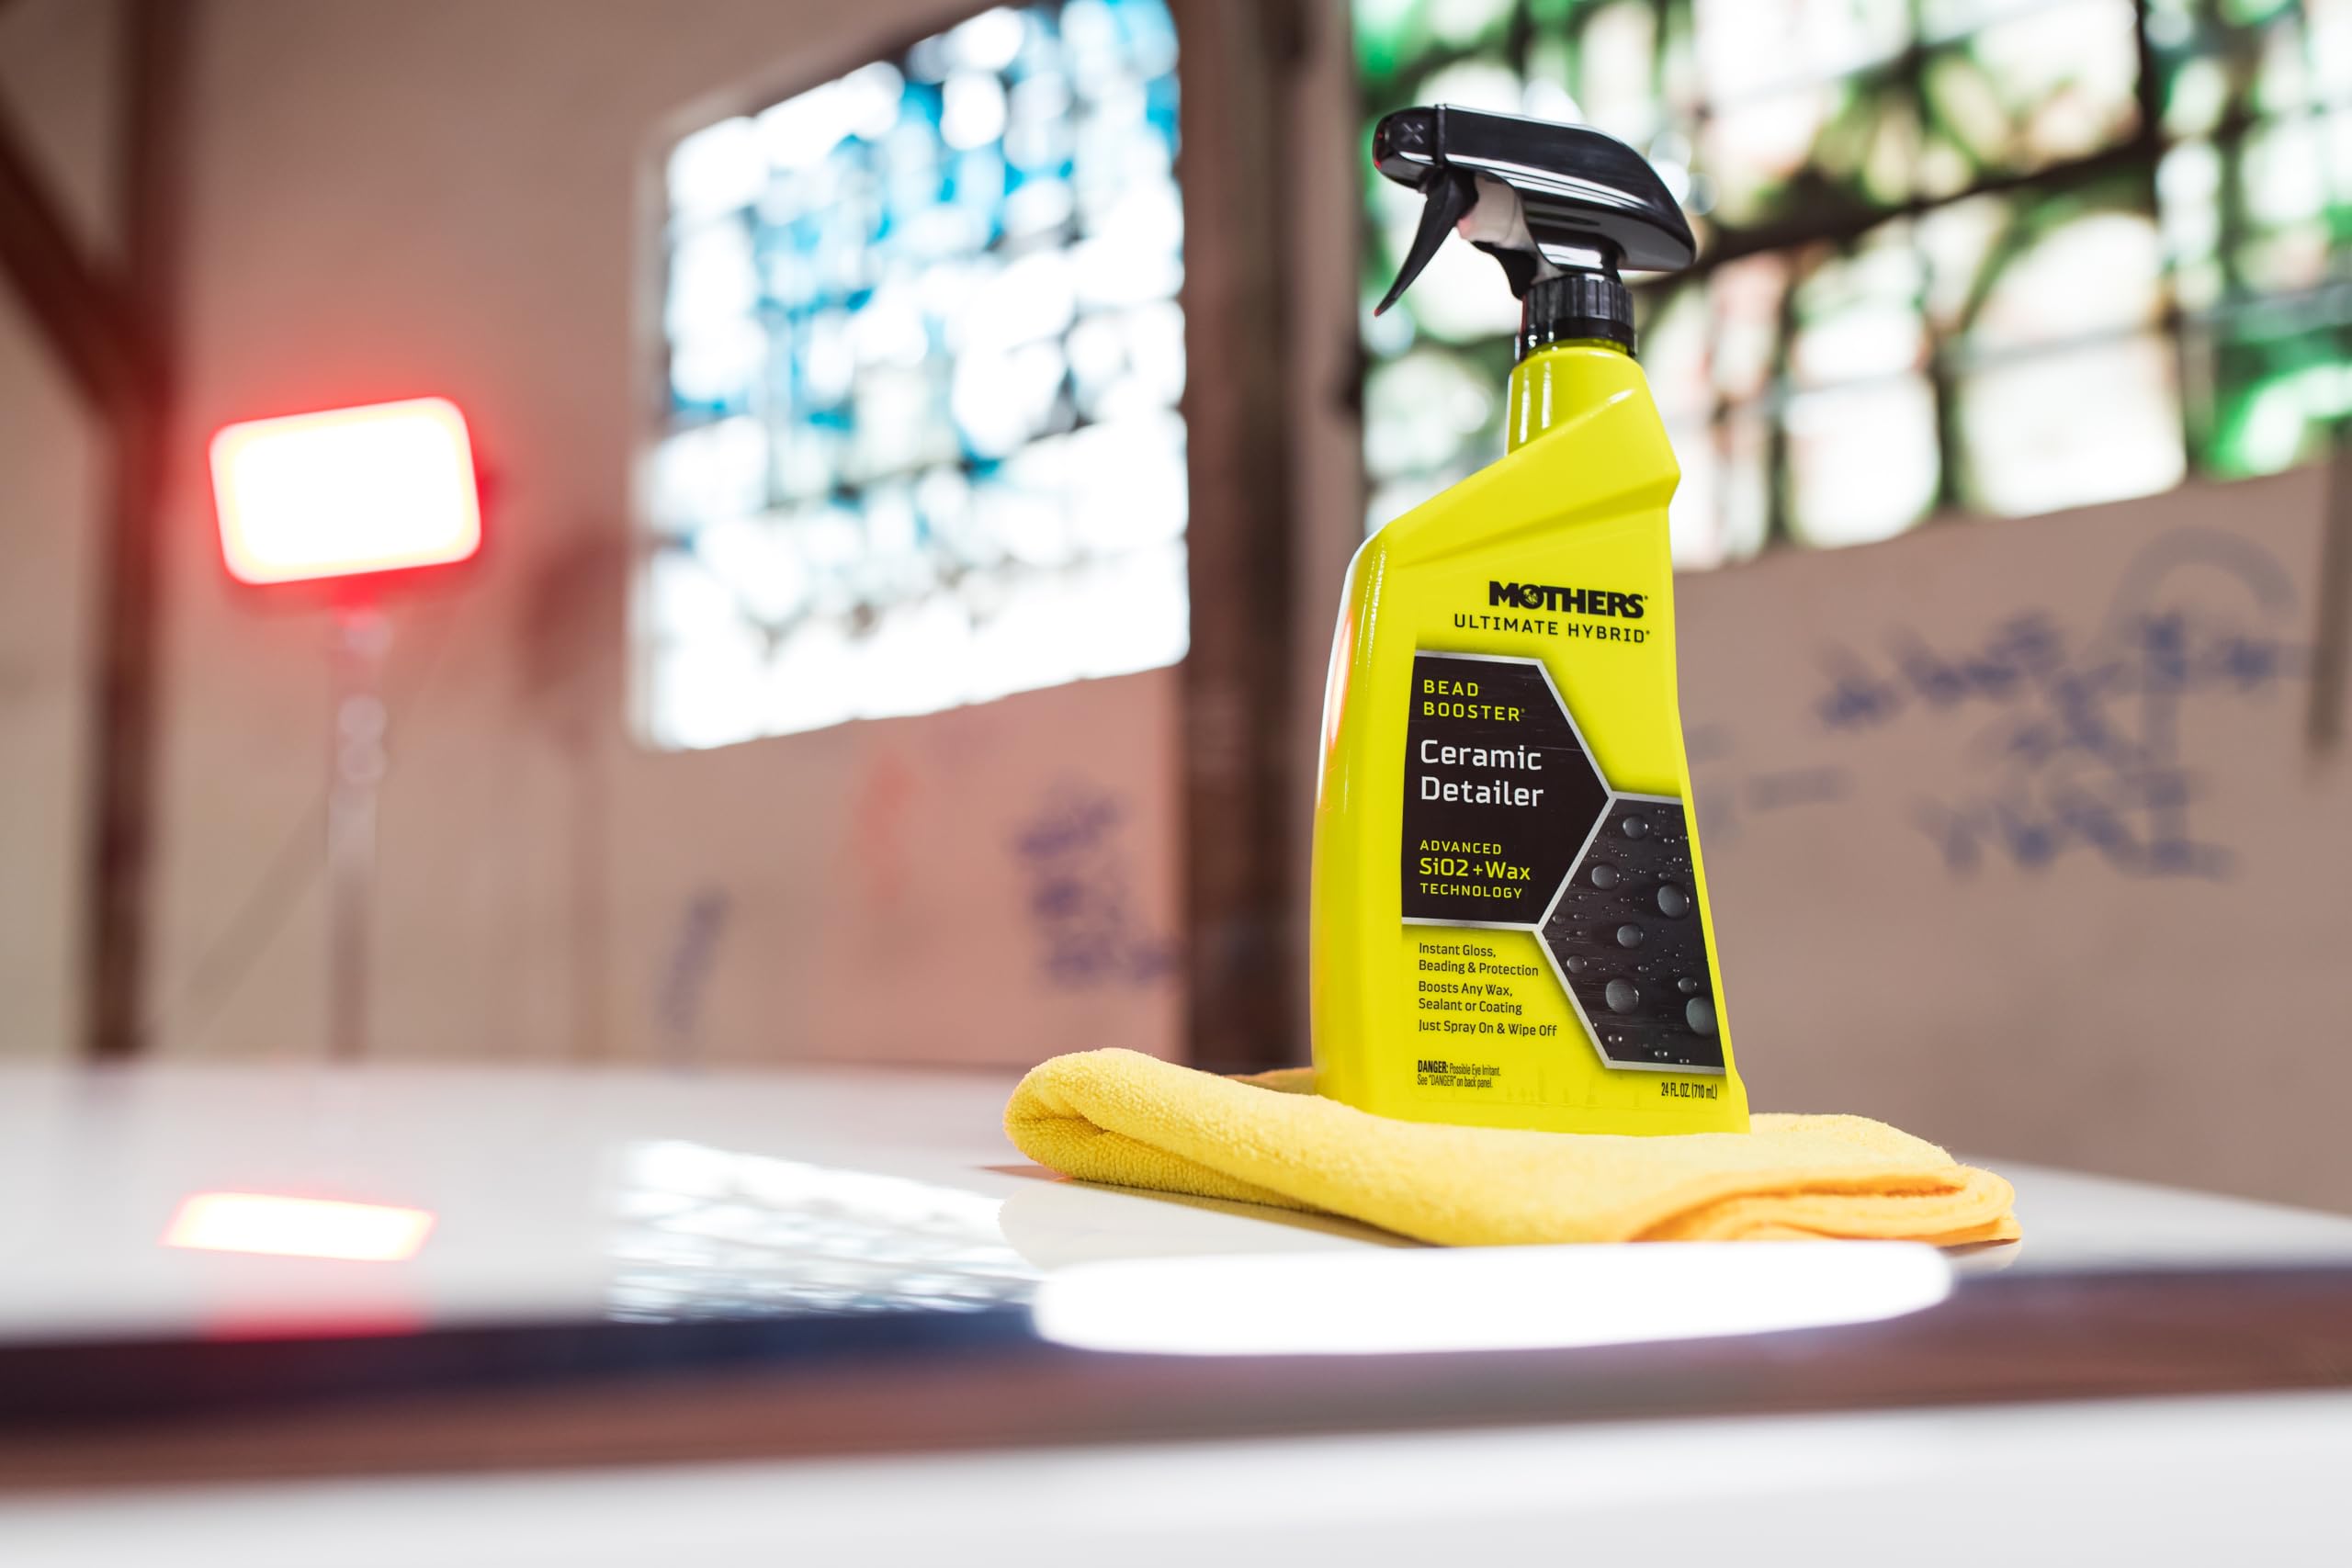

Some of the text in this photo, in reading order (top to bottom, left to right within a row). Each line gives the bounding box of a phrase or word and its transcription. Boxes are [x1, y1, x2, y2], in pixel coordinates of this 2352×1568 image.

[1488, 581, 1645, 619] MOTHERS
[1454, 613, 1645, 643] ULTIMATE HYBRID
[1423, 680, 1479, 697] BEAD
[1423, 702, 1521, 722] BOOSTER
[1420, 739, 1543, 771] Ceramic
[1420, 775, 1544, 807] Detailer
[1419, 840, 1502, 855] ADVANCED
[1419, 883, 1522, 899] TECHNOLOGY
[1419, 942, 1497, 958] Instant Gloss,
[1419, 960, 1539, 976] Beading & Protection
[1419, 981, 1513, 997] Boosts Any Wax,
[1419, 998, 1522, 1015] Sealant or Coating
[1419, 1020, 1557, 1037] Just Spray On & Wipe Off
[1418, 1060, 1449, 1074] DANGER:
[1450, 1063, 1471, 1075] Possible
[1472, 1064, 1481, 1077] Eye
[1418, 1074, 1428, 1086] See
[1457, 1077, 1464, 1088] on
[1464, 1076, 1476, 1088] back
[1661, 1082, 1668, 1097] 24
[1691, 1082, 1705, 1100] (710
